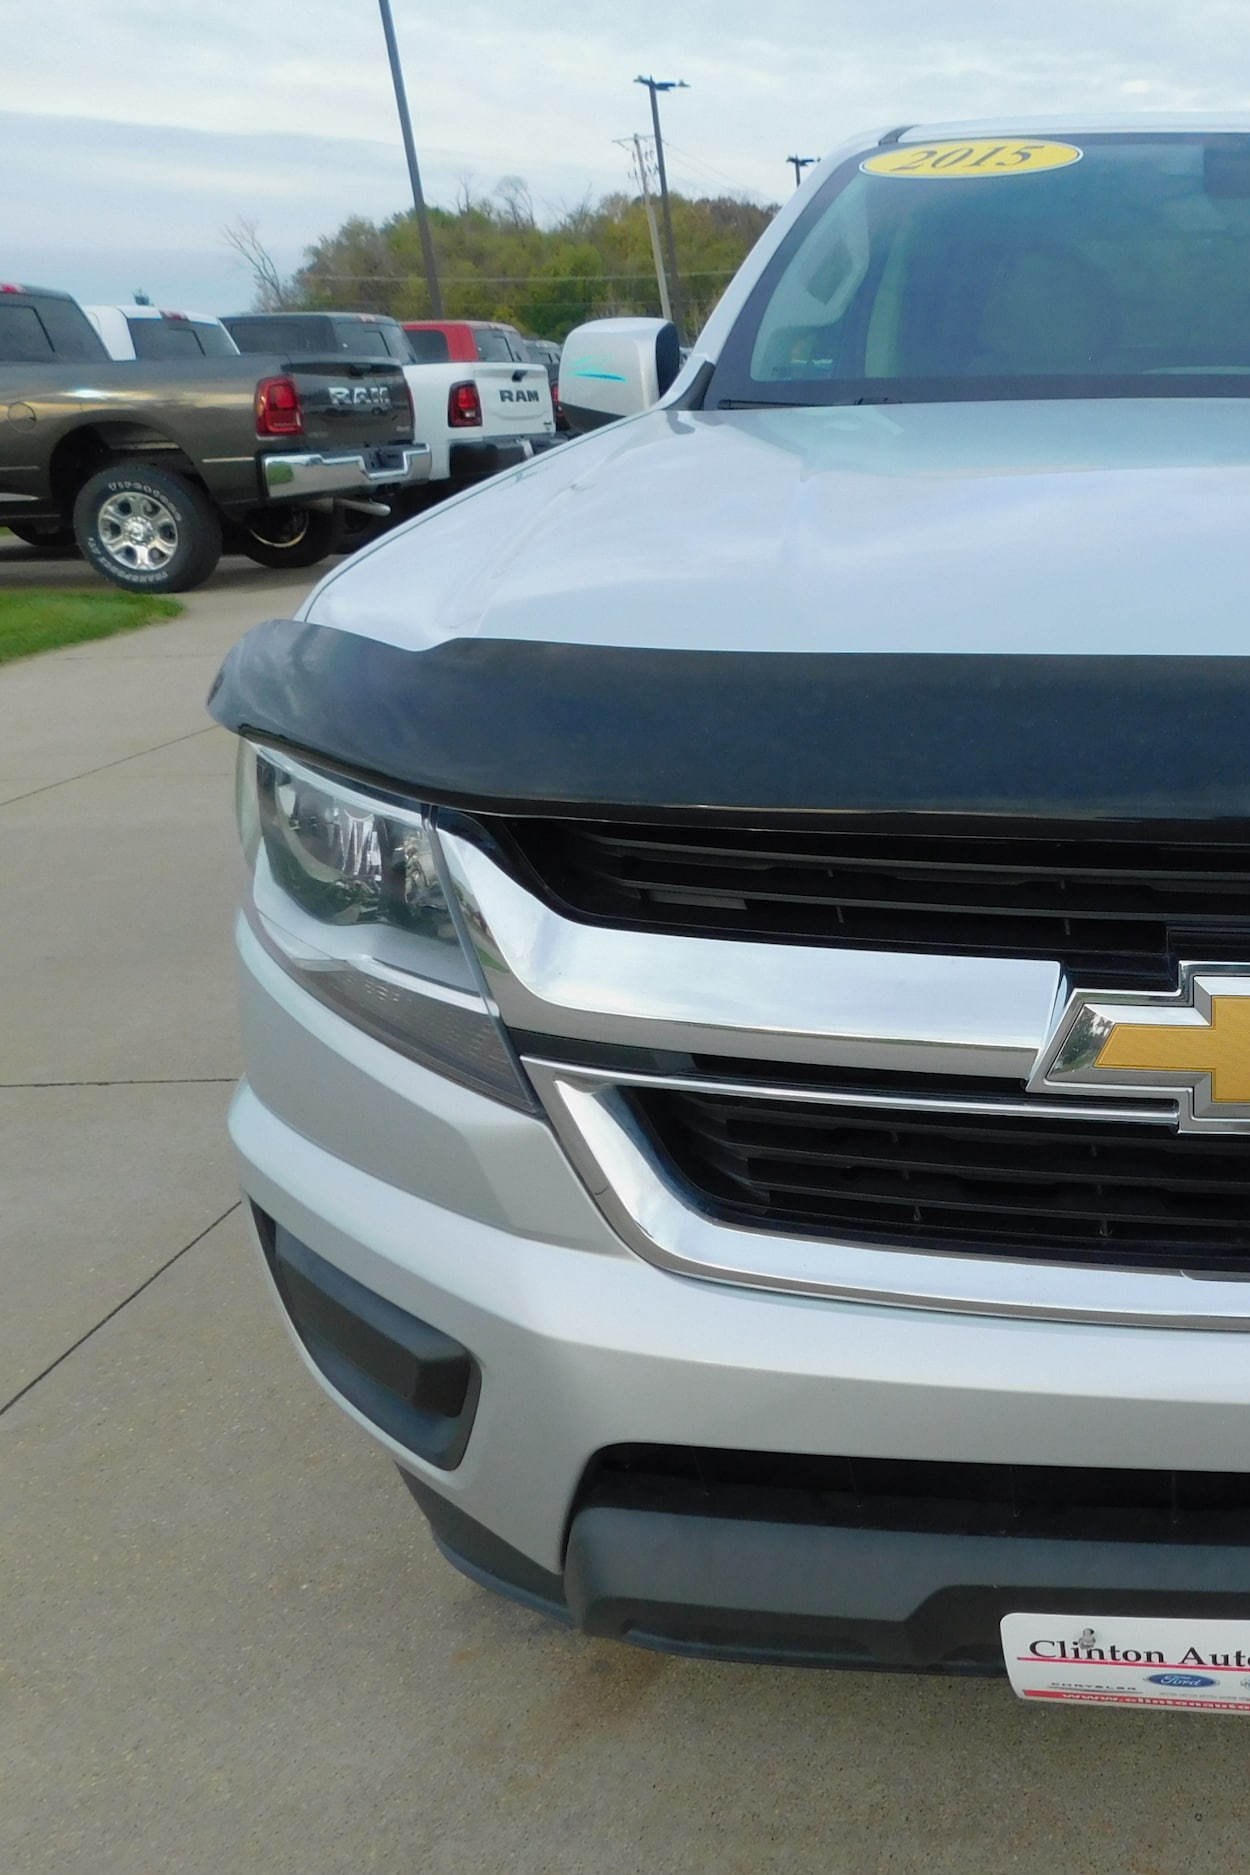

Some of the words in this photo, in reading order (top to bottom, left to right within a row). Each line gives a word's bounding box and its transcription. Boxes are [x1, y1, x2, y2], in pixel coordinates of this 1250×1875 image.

[889, 145, 1045, 172] 2015
[328, 387, 390, 404] RAM
[499, 390, 539, 402] RAM
[1029, 1640, 1166, 1664] Clinton
[1051, 1682, 1137, 1691] CHRYSLER
[1161, 1675, 1202, 1686] Ford
